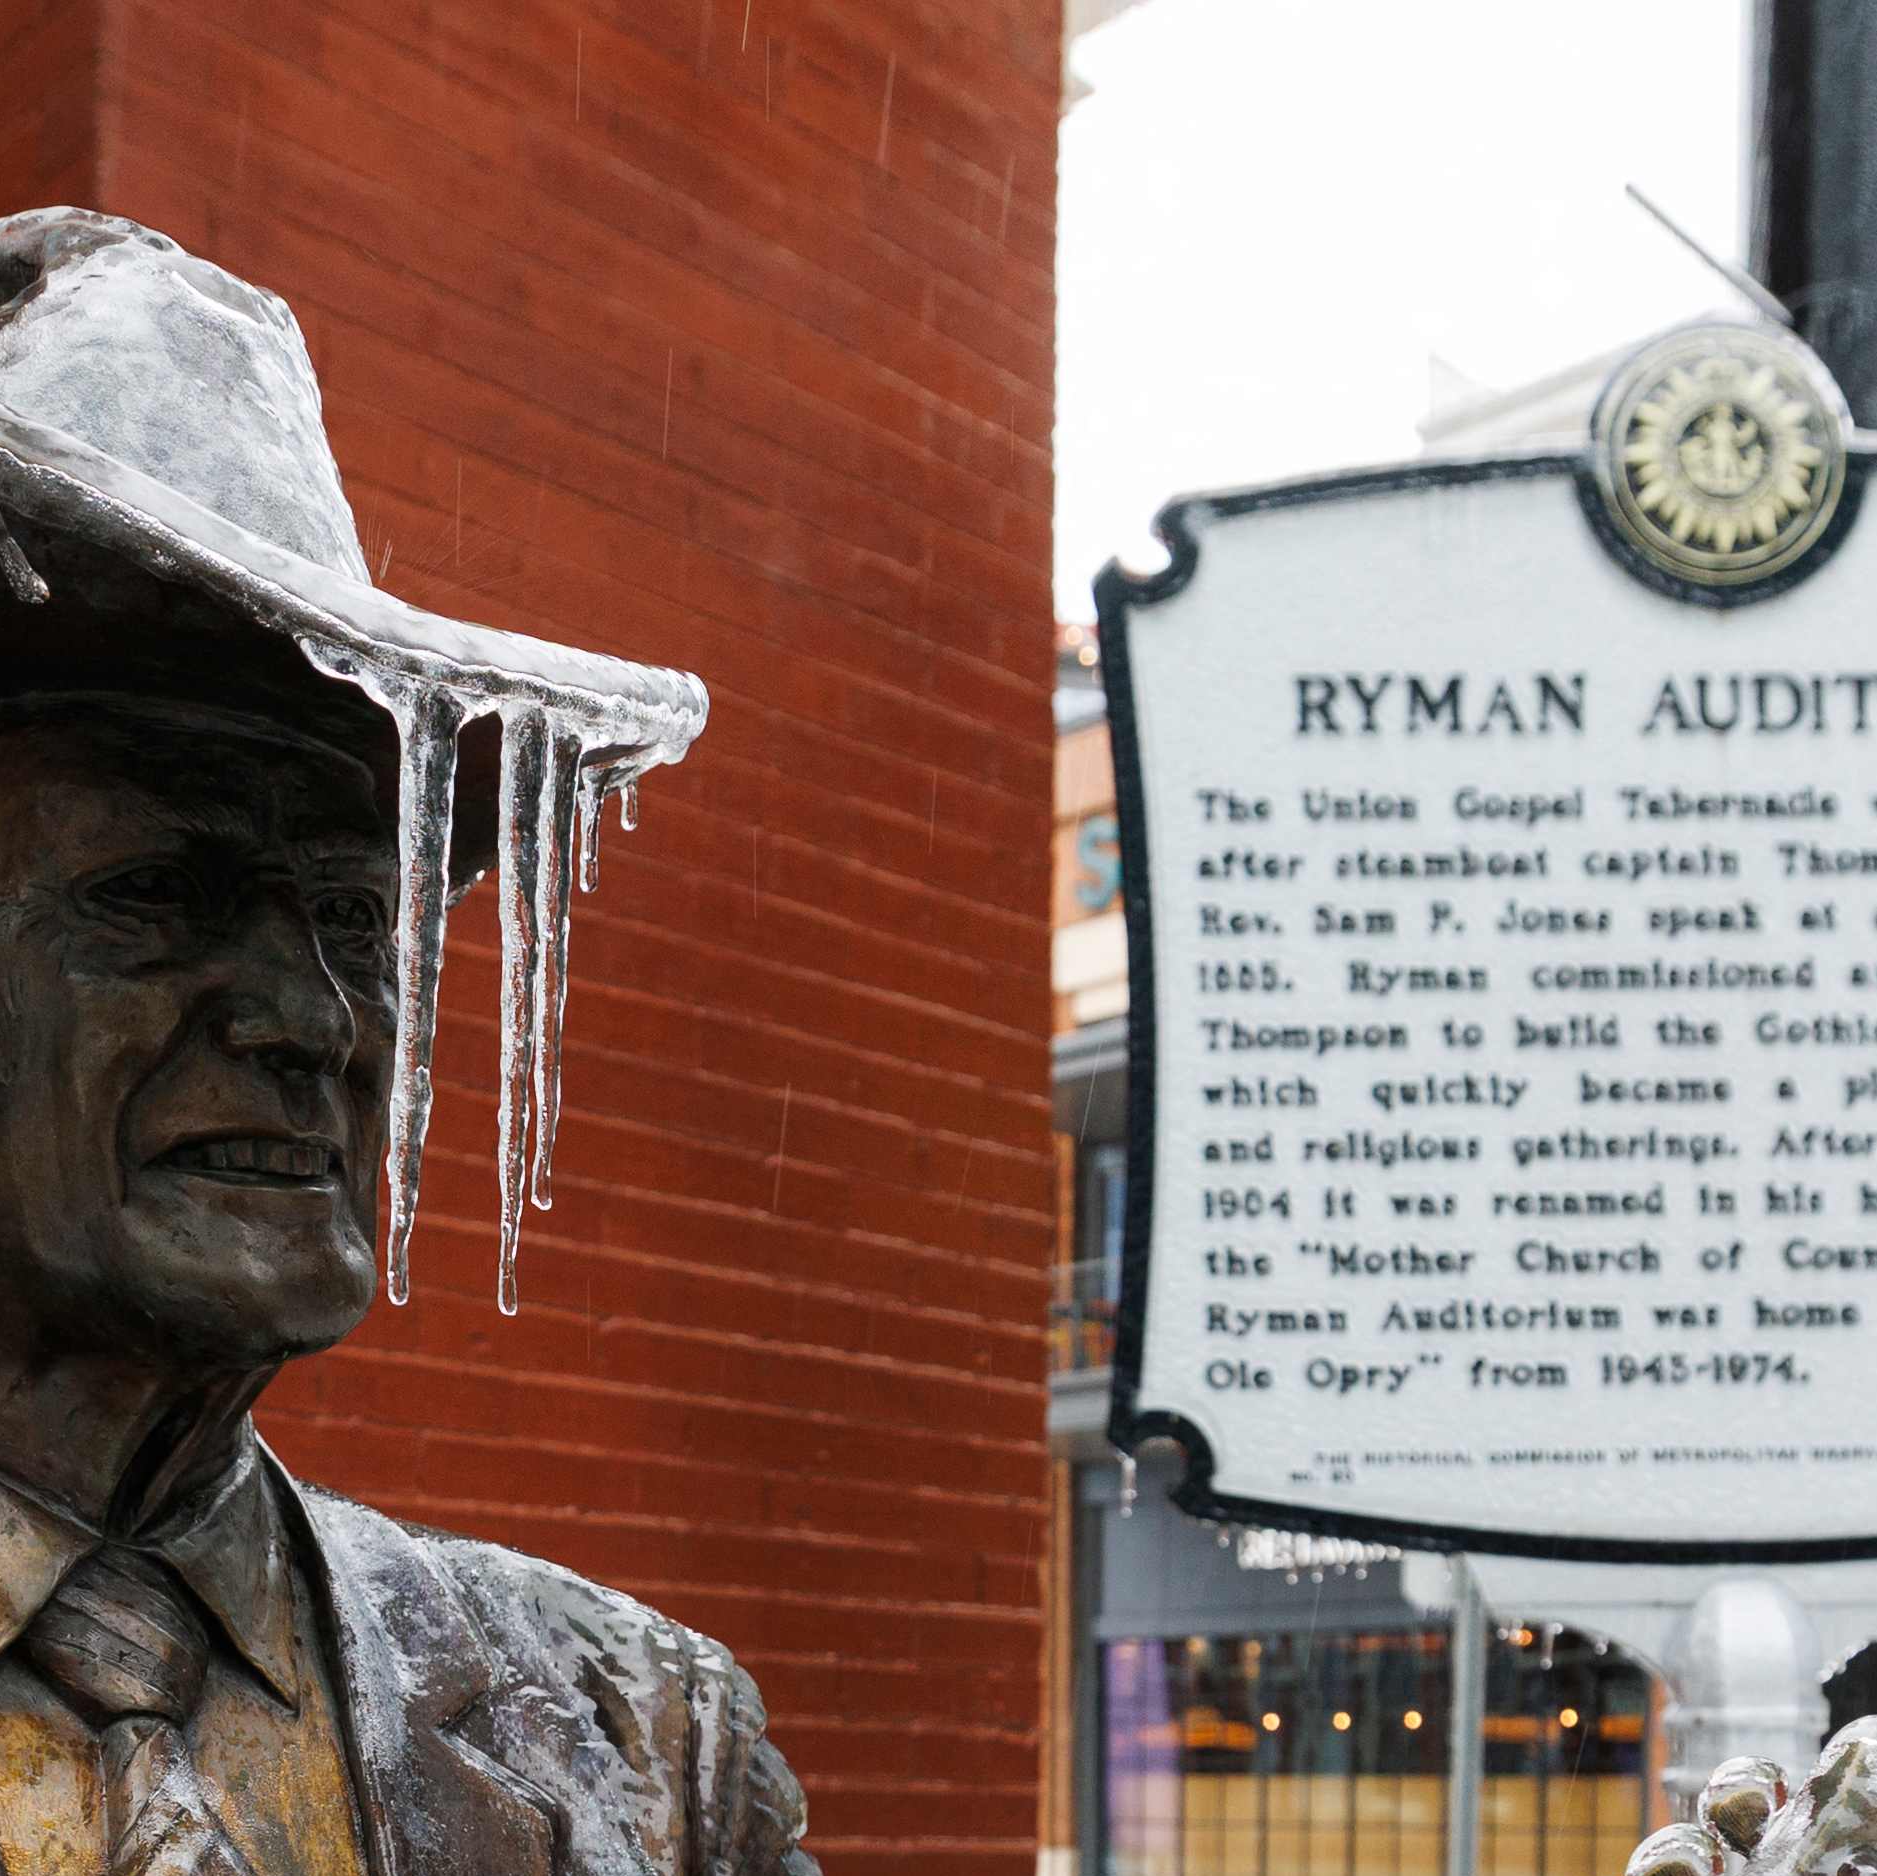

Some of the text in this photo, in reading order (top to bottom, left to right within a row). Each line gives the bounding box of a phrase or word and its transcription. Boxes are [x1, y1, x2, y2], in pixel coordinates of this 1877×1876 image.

[1291, 672, 1588, 737] RYMAN
[1194, 788, 1273, 825] The
[1300, 789, 1419, 823] Union
[1451, 787, 1585, 828] Gospel
[1617, 787, 1839, 821] Tabernacle
[1195, 848, 1304, 881] after
[1334, 846, 1549, 880] steamboat
[1581, 847, 1739, 883] captain
[1198, 905, 1283, 937] Rev.
[1312, 904, 1397, 937] Sam
[1428, 901, 1465, 934] P.
[1496, 900, 1612, 935] Jones
[1648, 900, 1762, 939] speak
[1797, 903, 1837, 932] at
[1346, 960, 1489, 998] Ryman
[1529, 959, 1816, 992] commissioned
[1200, 1019, 1409, 1057] Thompson
[1440, 1020, 1485, 1050] to
[1514, 1014, 1621, 1050] build
[1654, 1015, 1721, 1047] the
[1200, 1076, 1319, 1108] which
[1369, 1073, 1529, 1113] quickly
[1578, 1072, 1732, 1105] became
[1774, 1078, 1798, 1102] a
[1201, 1132, 1275, 1165] and
[1301, 1130, 1482, 1170] religious
[1510, 1127, 1739, 1169] gatherings.
[1770, 1127, 1877, 1158] After
[1202, 1187, 1292, 1220] 1904
[1322, 1187, 1356, 1220] it
[1388, 1194, 1458, 1219] was
[1490, 1184, 1666, 1217] renamed
[1696, 1184, 1737, 1216] in
[1762, 1183, 1824, 1215] his
[1203, 1245, 1272, 1279] the
[1514, 1239, 1662, 1275] Church
[1697, 1239, 1746, 1273] of
[1203, 1303, 1349, 1339] Ryman
[1380, 1300, 1622, 1333] Auditorium
[1650, 1305, 1721, 1330] was
[1751, 1297, 1862, 1330] home
[1203, 1359, 1274, 1392] Ole
[1468, 1356, 1570, 1389] from
